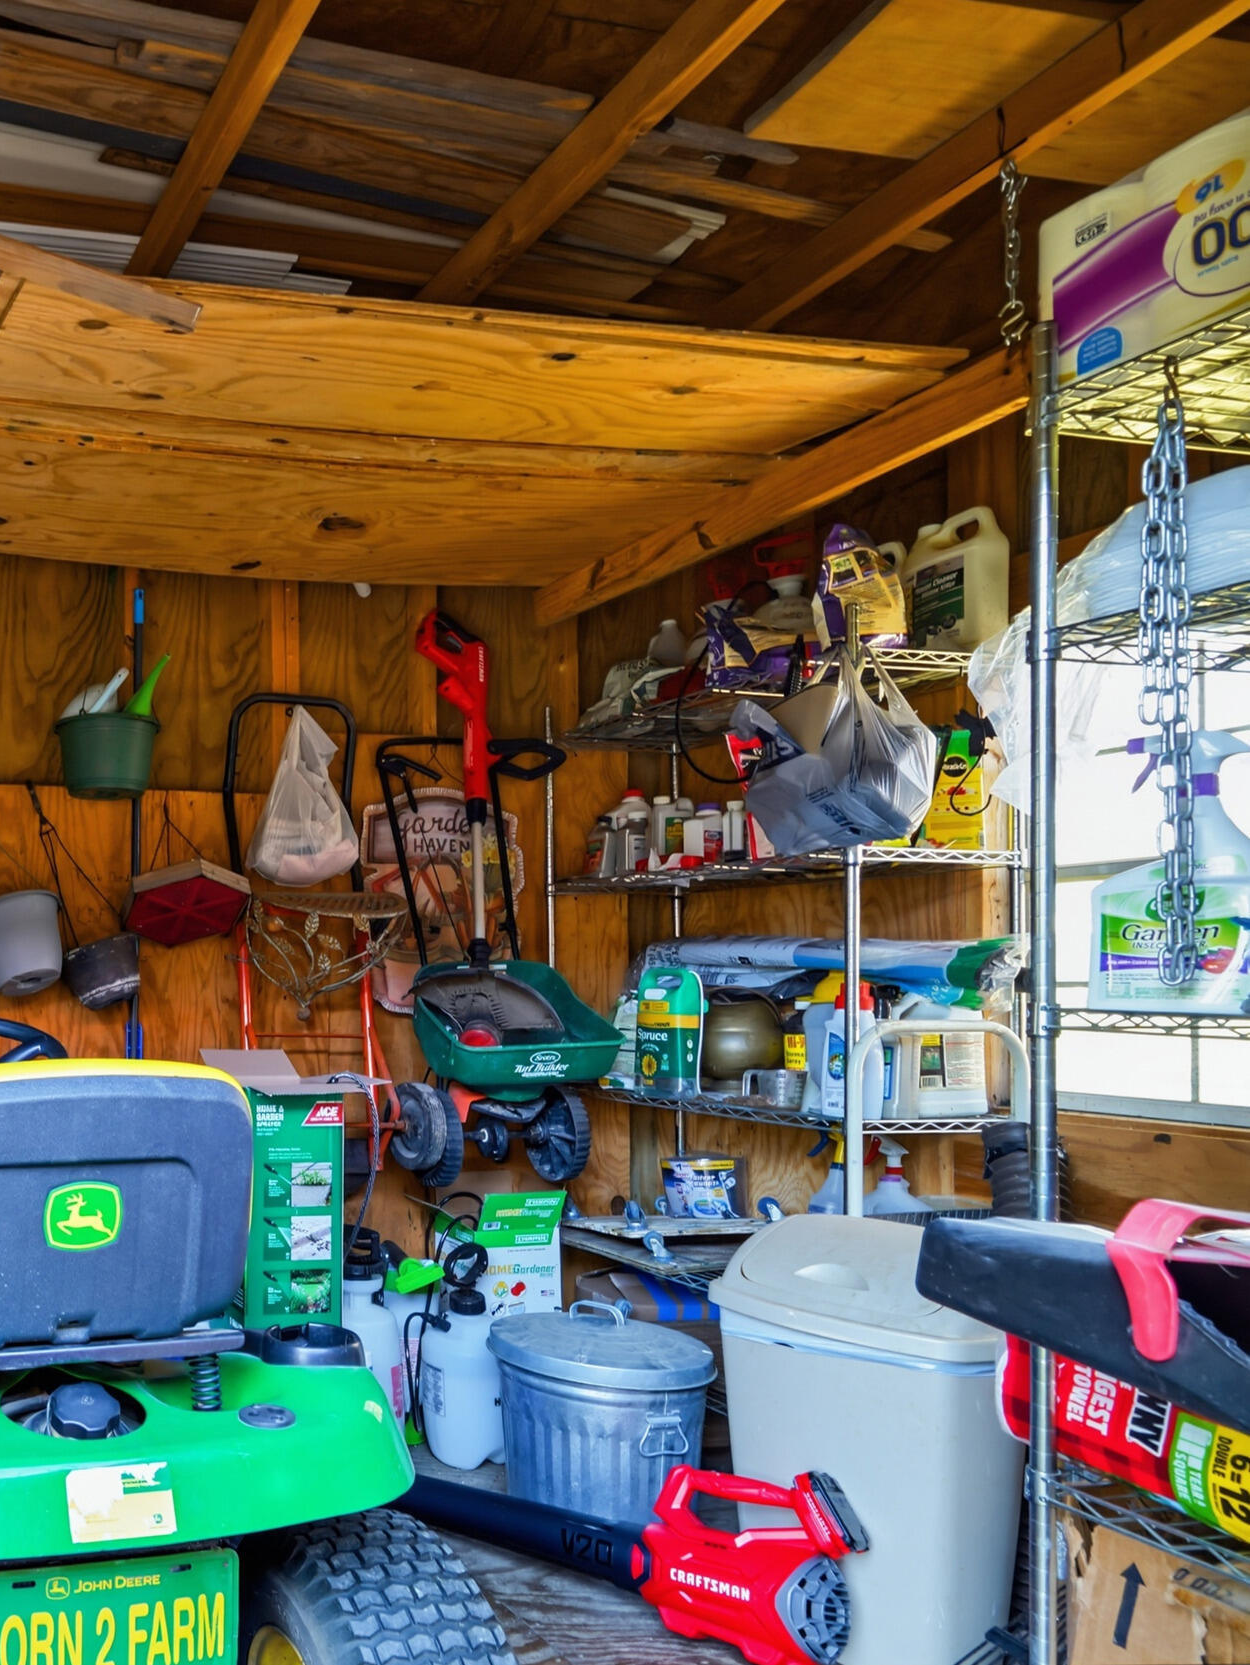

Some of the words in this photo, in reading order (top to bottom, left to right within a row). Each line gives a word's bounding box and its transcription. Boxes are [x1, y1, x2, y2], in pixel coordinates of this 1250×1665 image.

[399, 808, 471, 843] Garde
[413, 838, 470, 853] HAVEN
[1121, 923, 1220, 941] Garen
[637, 1028, 668, 1042] Spruce
[514, 1064, 535, 1073] Turf
[534, 1063, 570, 1072] Builder
[255, 1112, 284, 1121] GARDEN
[315, 1106, 339, 1117] ACE
[485, 1263, 556, 1276] OMEGardener
[1066, 1365, 1092, 1423] TOWEL
[1128, 1389, 1171, 1456] WNY
[1212, 1435, 1233, 1479] DOUBLE
[1173, 1451, 1193, 1505] SQUARE
[560, 1527, 614, 1568] V20
[73, 1579, 113, 1594] JOHN
[114, 1574, 161, 1590] DEERE
[669, 1566, 751, 1602] CRAFTSMAN
[95, 1606, 116, 1665] 2
[128, 1591, 225, 1665] FARM
